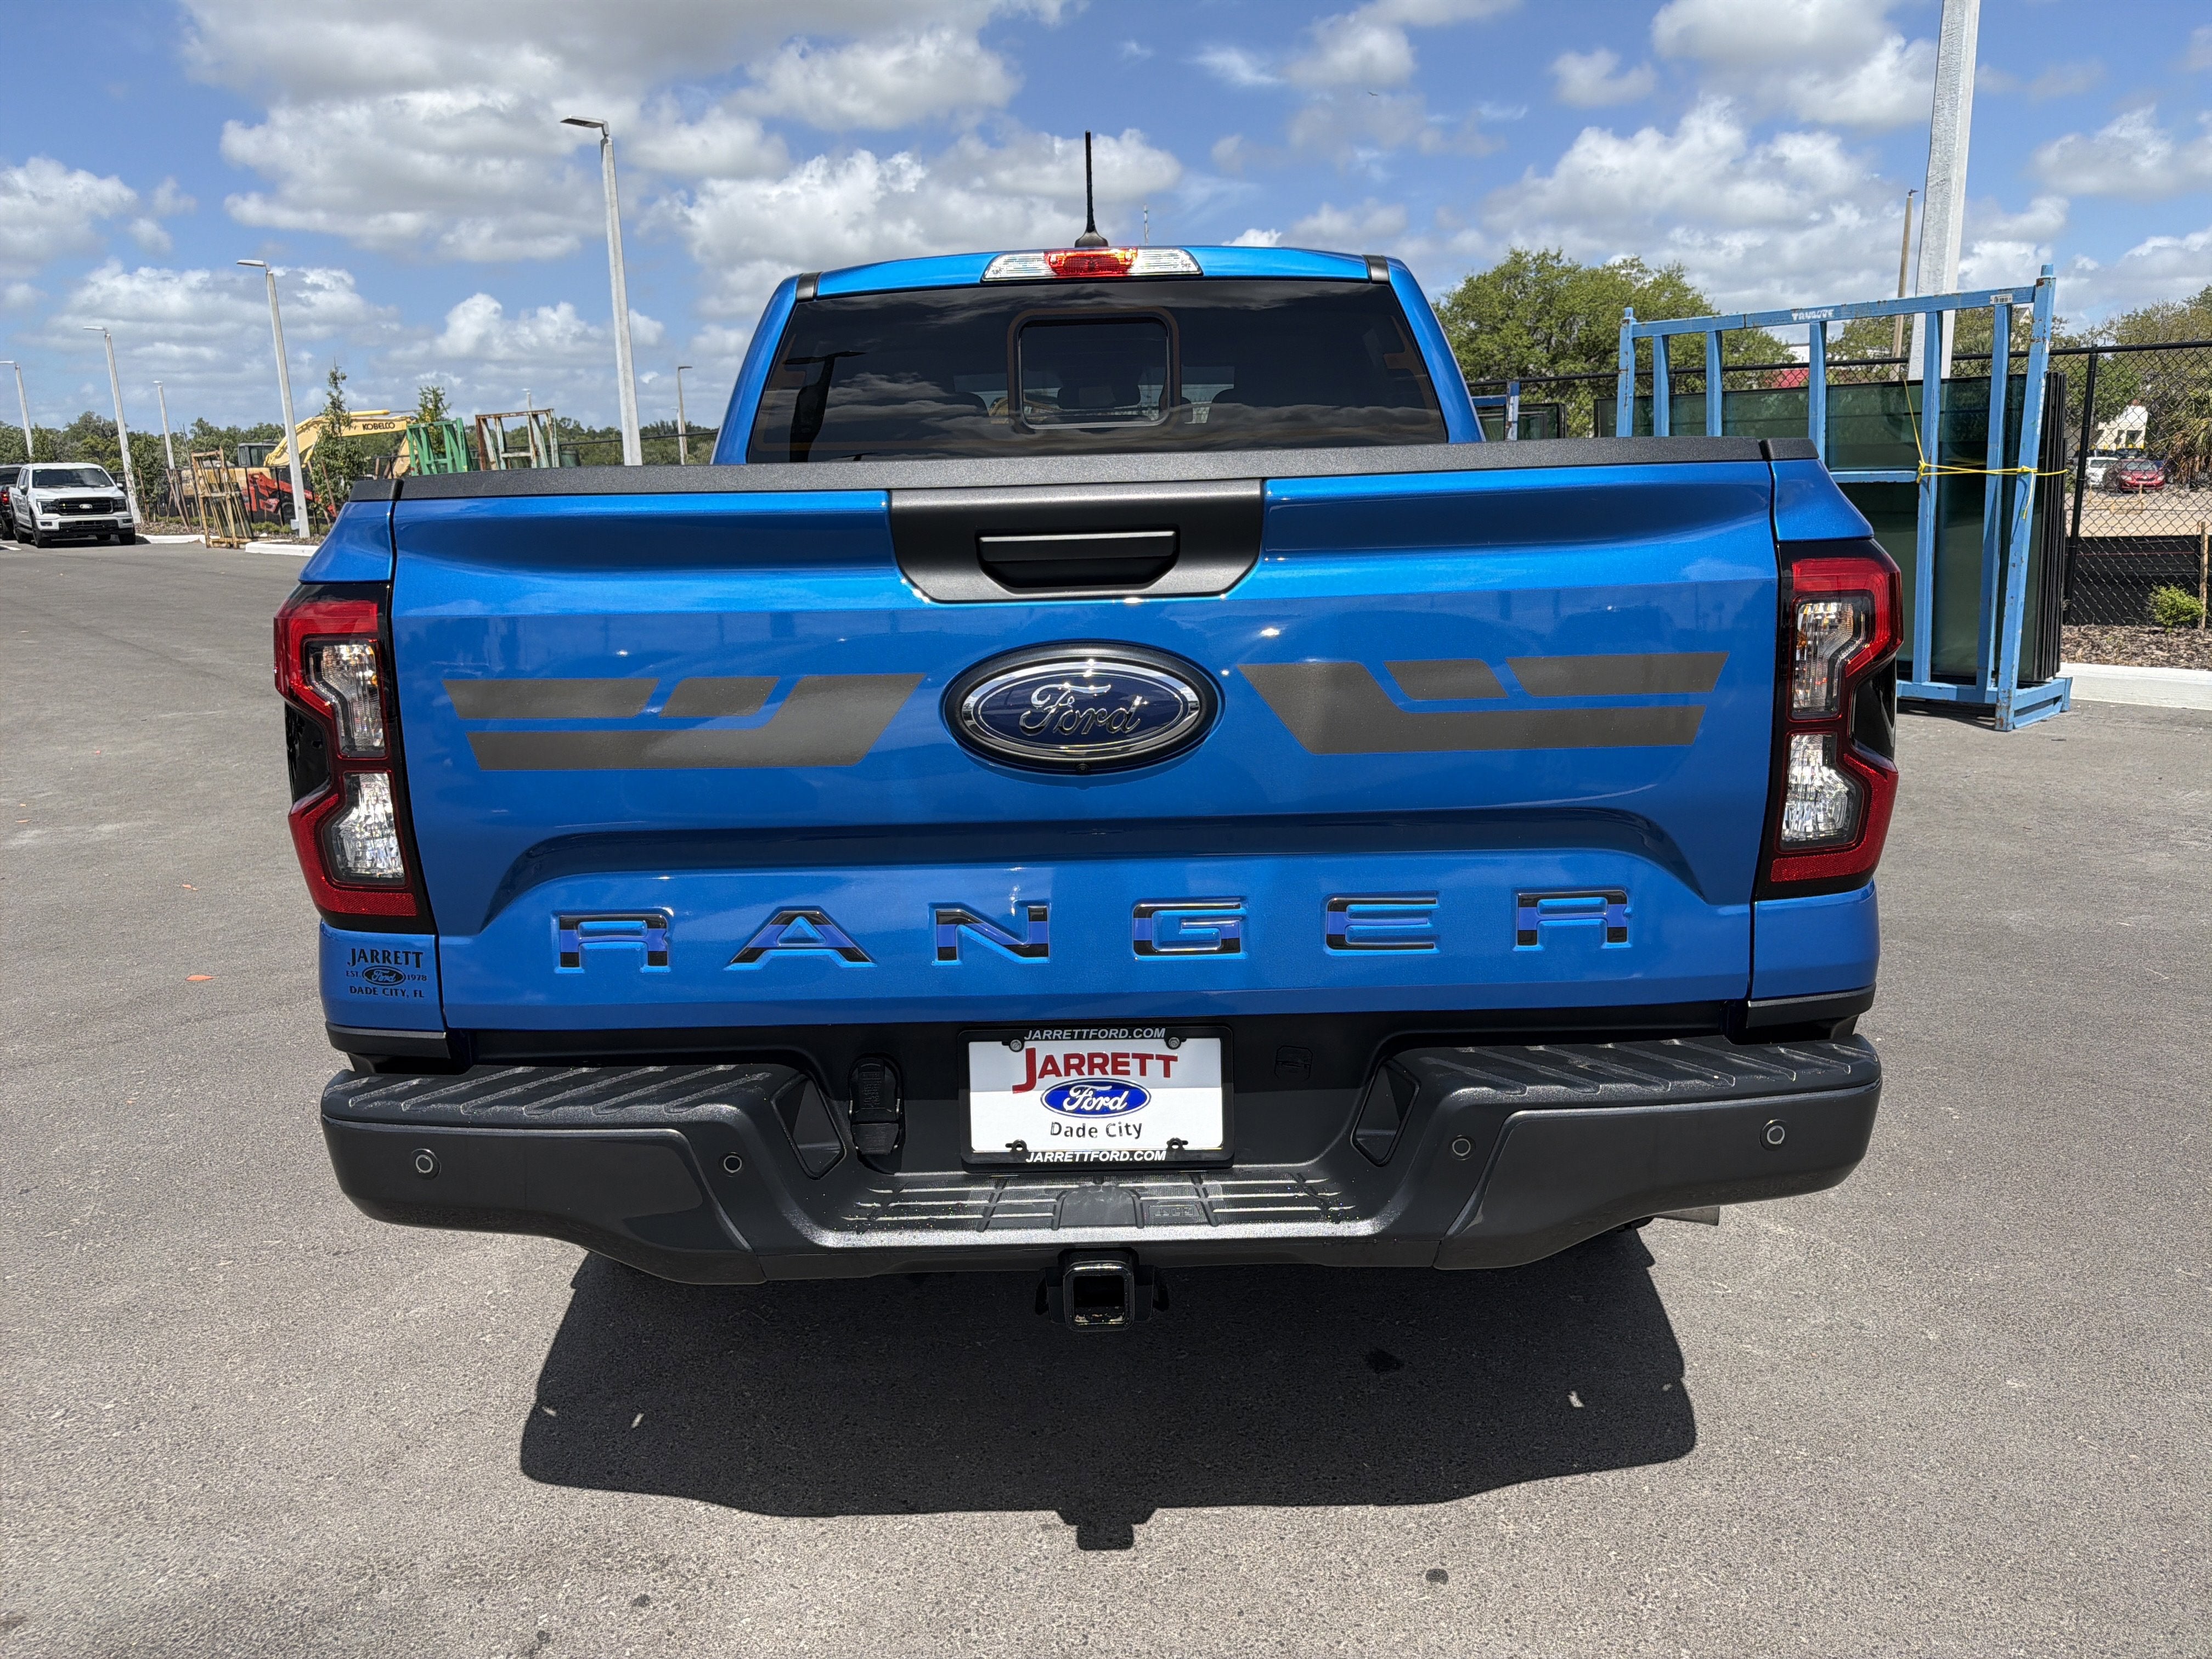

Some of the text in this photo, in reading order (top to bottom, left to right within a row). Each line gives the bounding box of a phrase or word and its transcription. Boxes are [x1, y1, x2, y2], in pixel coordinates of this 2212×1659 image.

[362, 422, 396, 431] KOBELCO
[1019, 682, 1143, 736] Ford
[554, 887, 1632, 976] RANGER
[347, 948, 424, 968] JARRETT
[371, 969, 396, 982] Ford
[349, 986, 425, 998] DADE CITY, FL
[1024, 1028, 1165, 1040] JARRETTFORD.COM
[1012, 1047, 1178, 1094] JARRETT
[1063, 1084, 1128, 1111] Ford
[1051, 1121, 1142, 1139] Dade City
[1026, 1151, 1166, 1163] JARRETTFORD.COM
